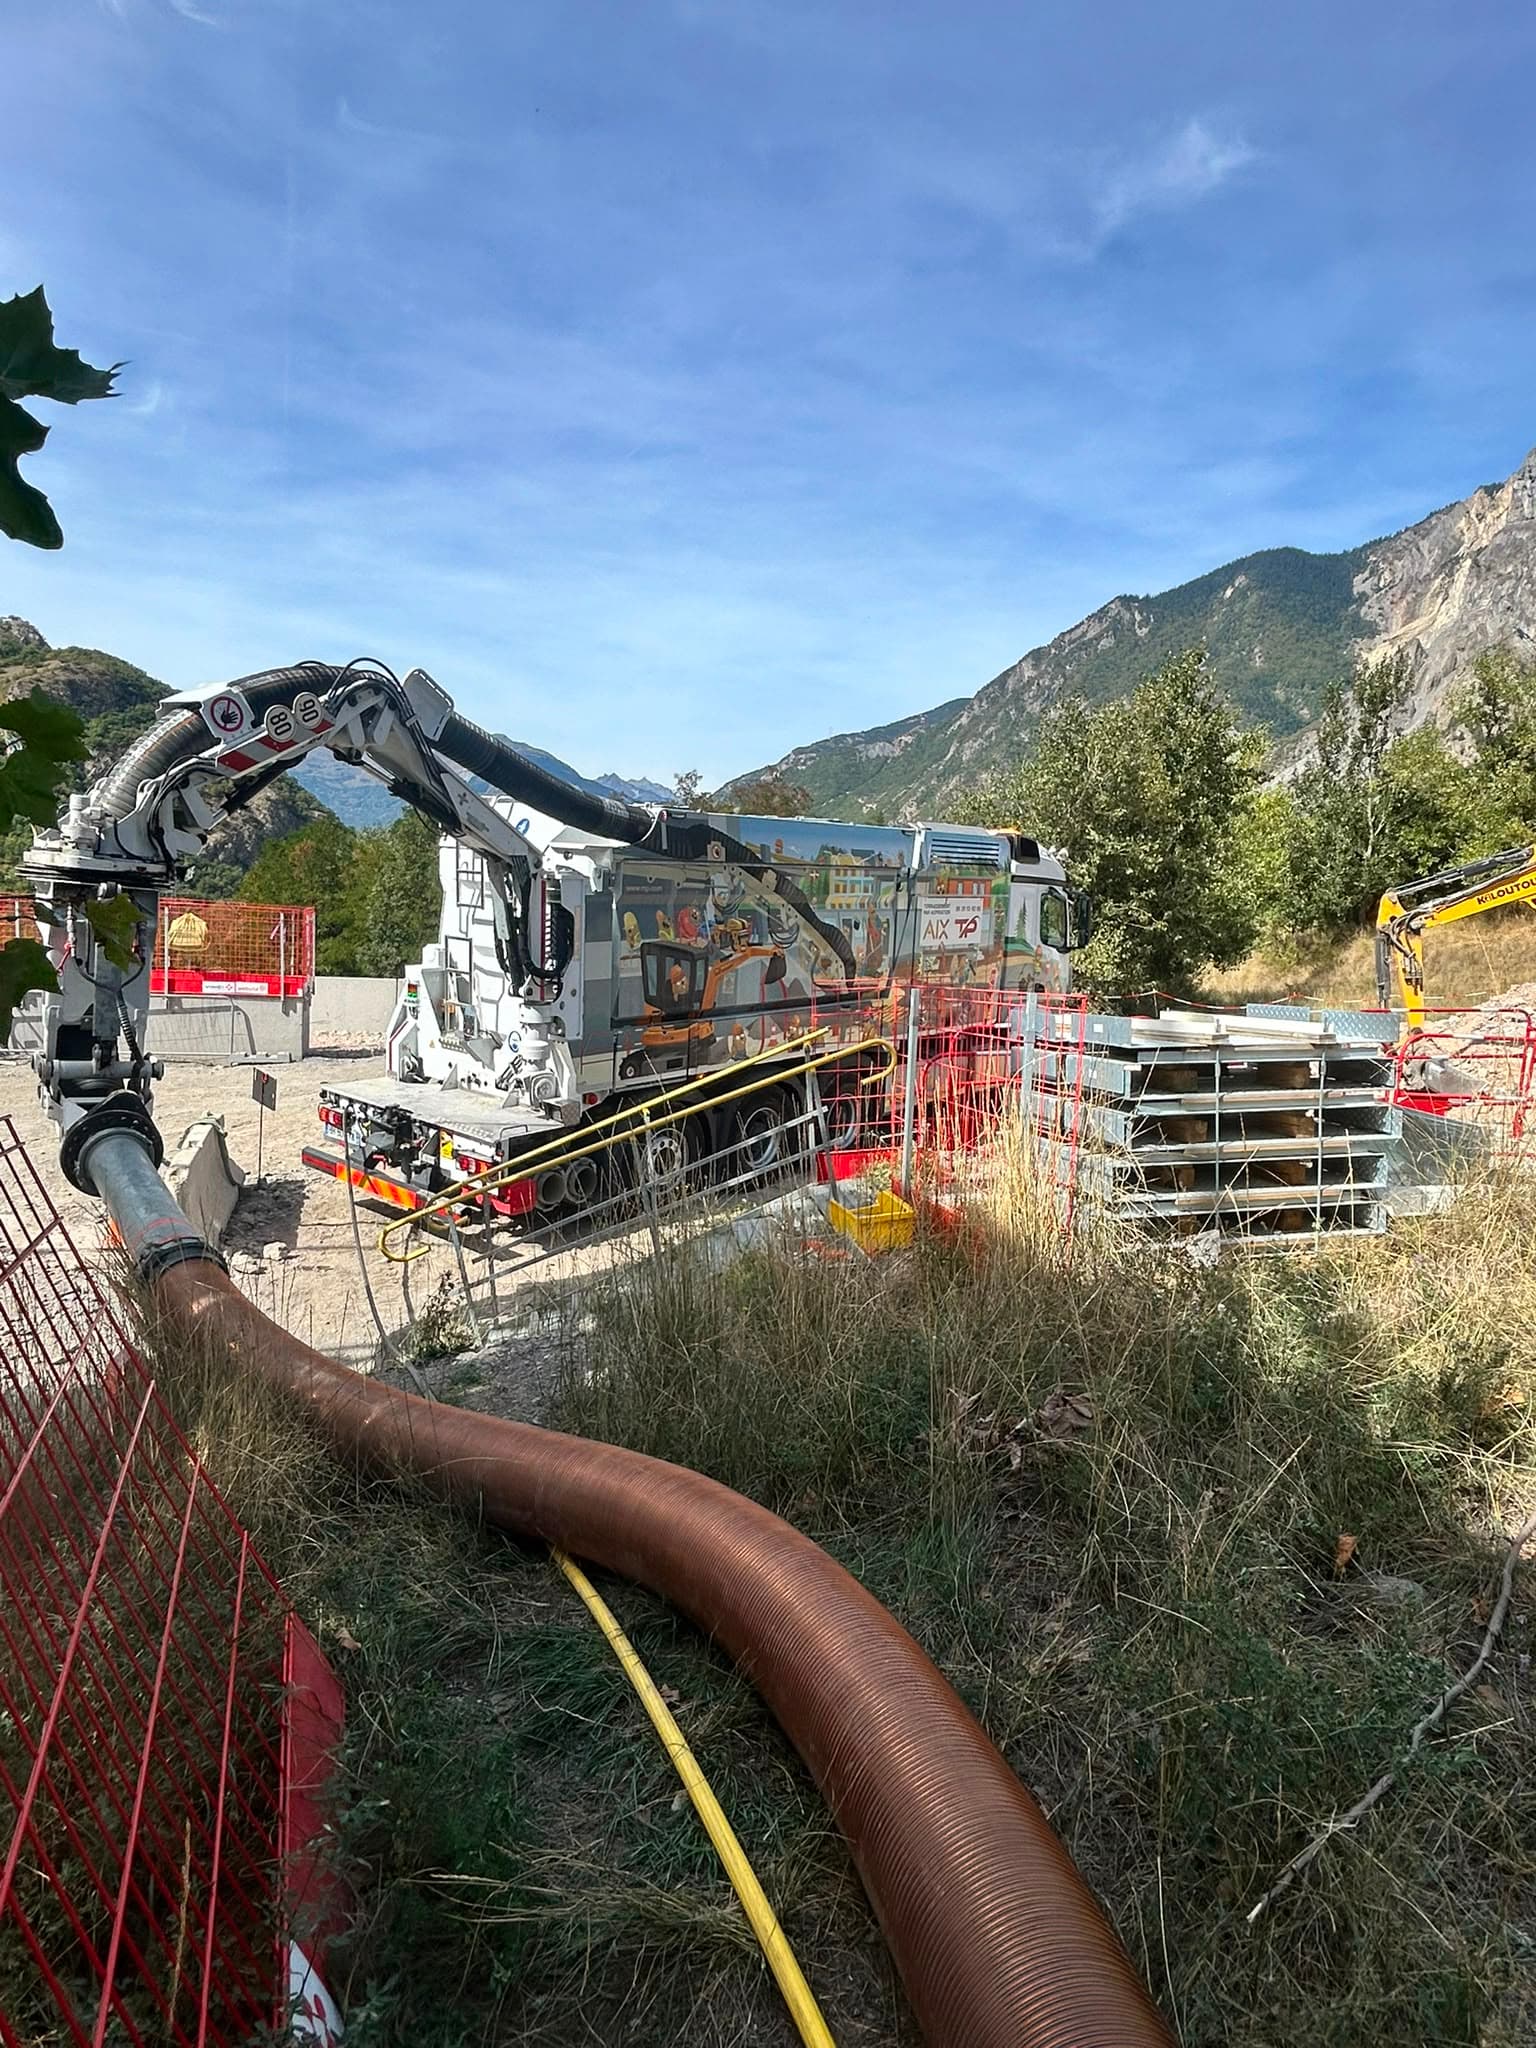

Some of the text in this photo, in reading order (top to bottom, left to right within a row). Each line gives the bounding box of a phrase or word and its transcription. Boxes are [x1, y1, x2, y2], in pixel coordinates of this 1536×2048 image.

[300, 699, 319, 722] 90
[270, 712, 291, 735] 80
[923, 915, 980, 940] AIX TP
